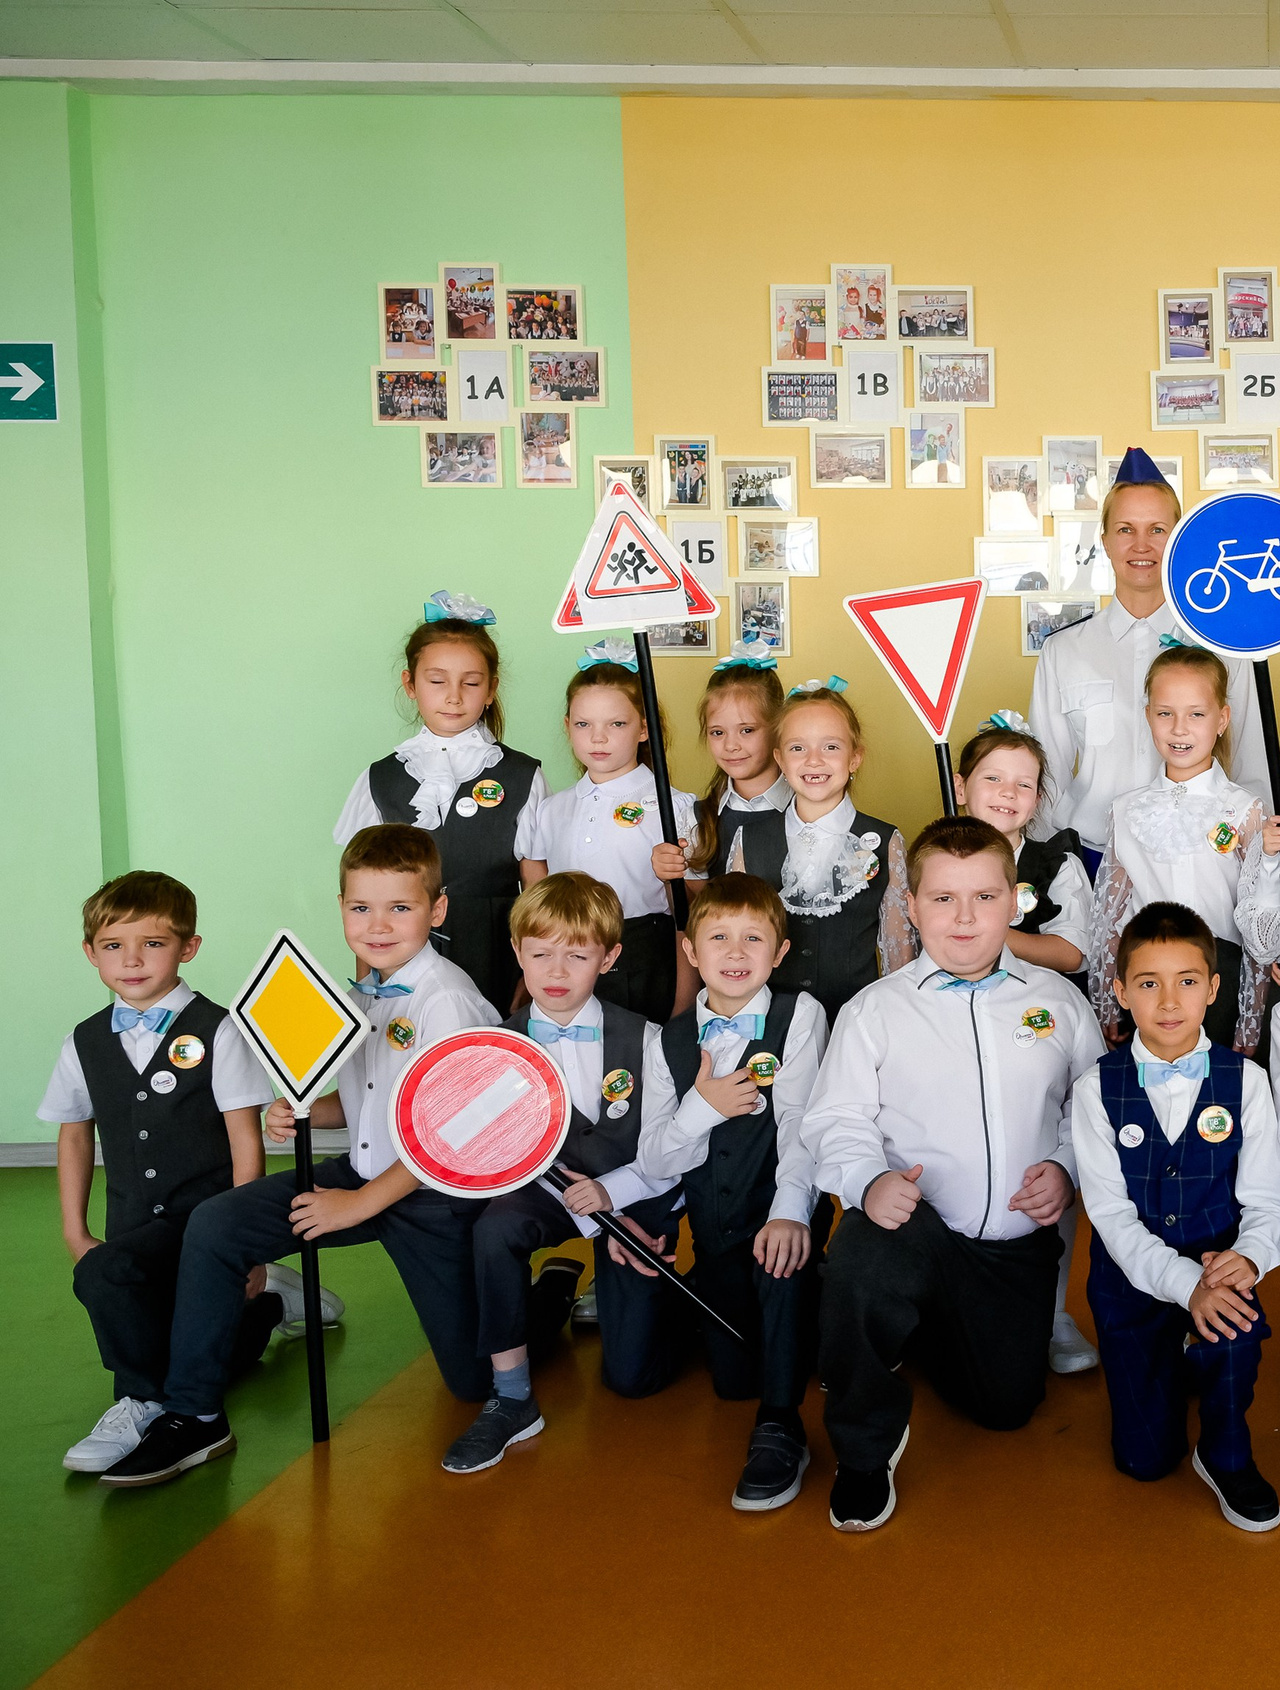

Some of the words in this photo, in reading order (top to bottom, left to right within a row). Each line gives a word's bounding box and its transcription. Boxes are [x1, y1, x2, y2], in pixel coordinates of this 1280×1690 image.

[466, 374, 505, 400] 1А
[857, 372, 889, 396] 1В
[1243, 374, 1276, 397] 2Б
[680, 539, 715, 564] 1Б
